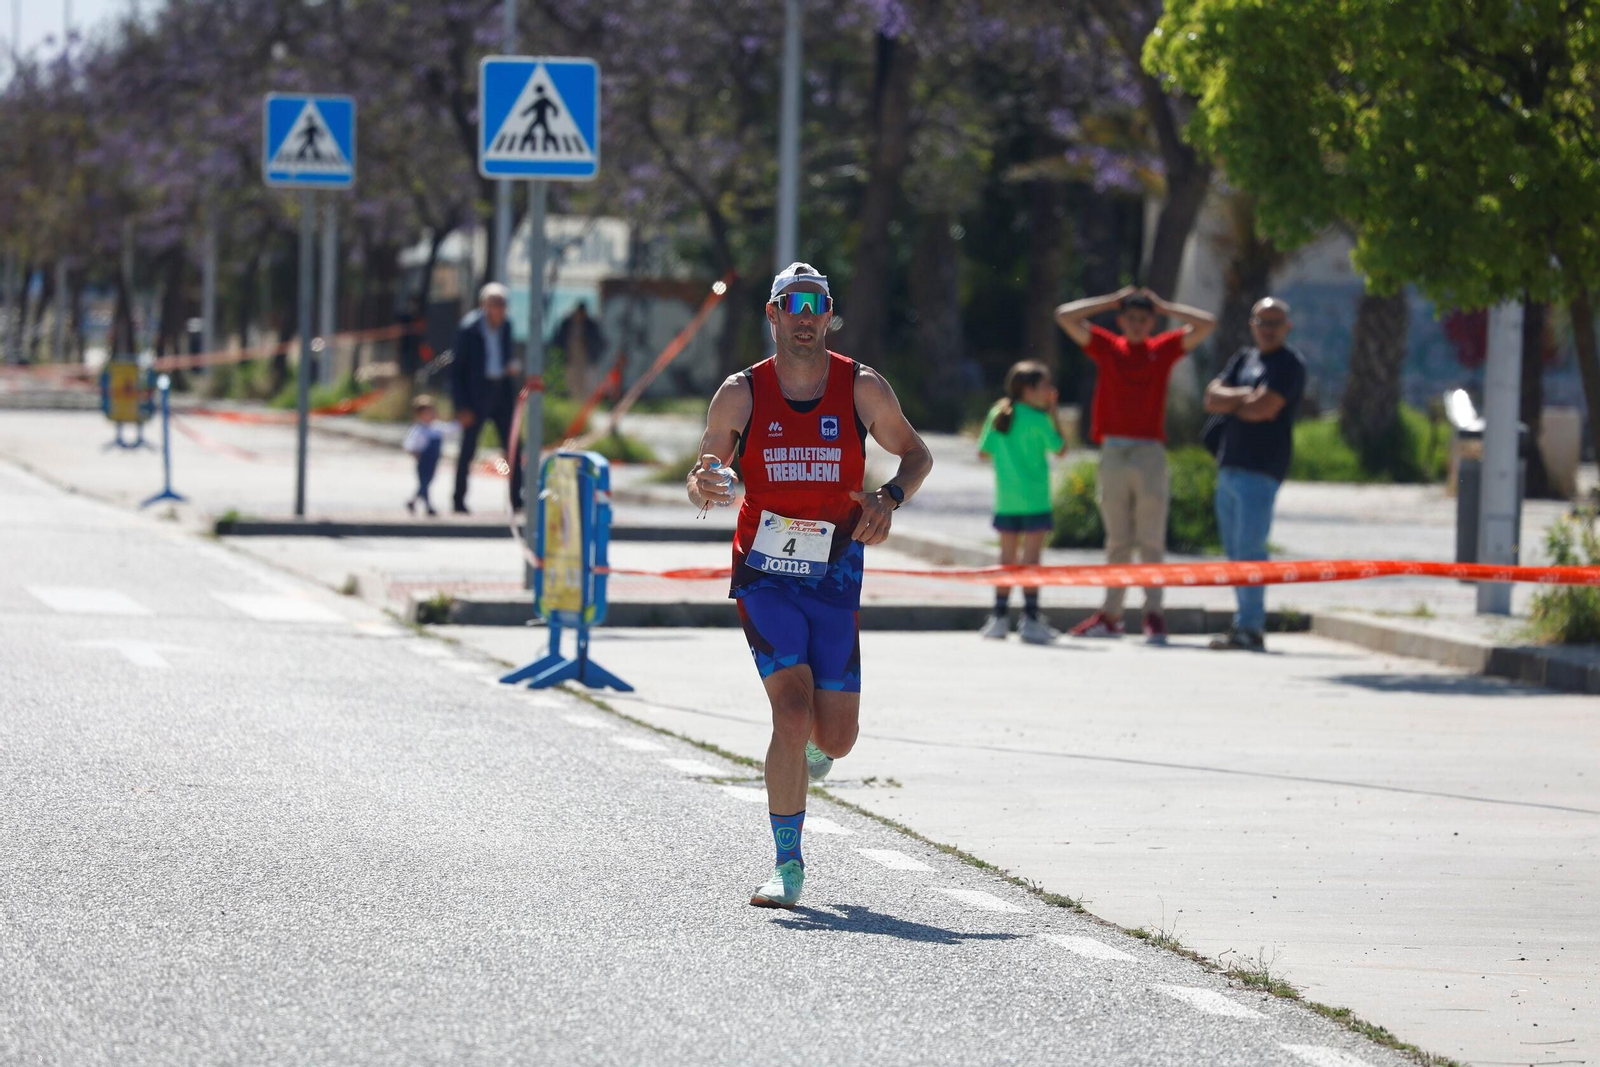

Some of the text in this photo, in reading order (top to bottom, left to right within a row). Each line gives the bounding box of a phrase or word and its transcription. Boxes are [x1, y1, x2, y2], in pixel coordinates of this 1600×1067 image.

[763, 448, 842, 462] CLUB ATLETISMO
[765, 463, 840, 482] TREBUJENA
[782, 538, 796, 556] 4
[761, 556, 810, 574] Joma
